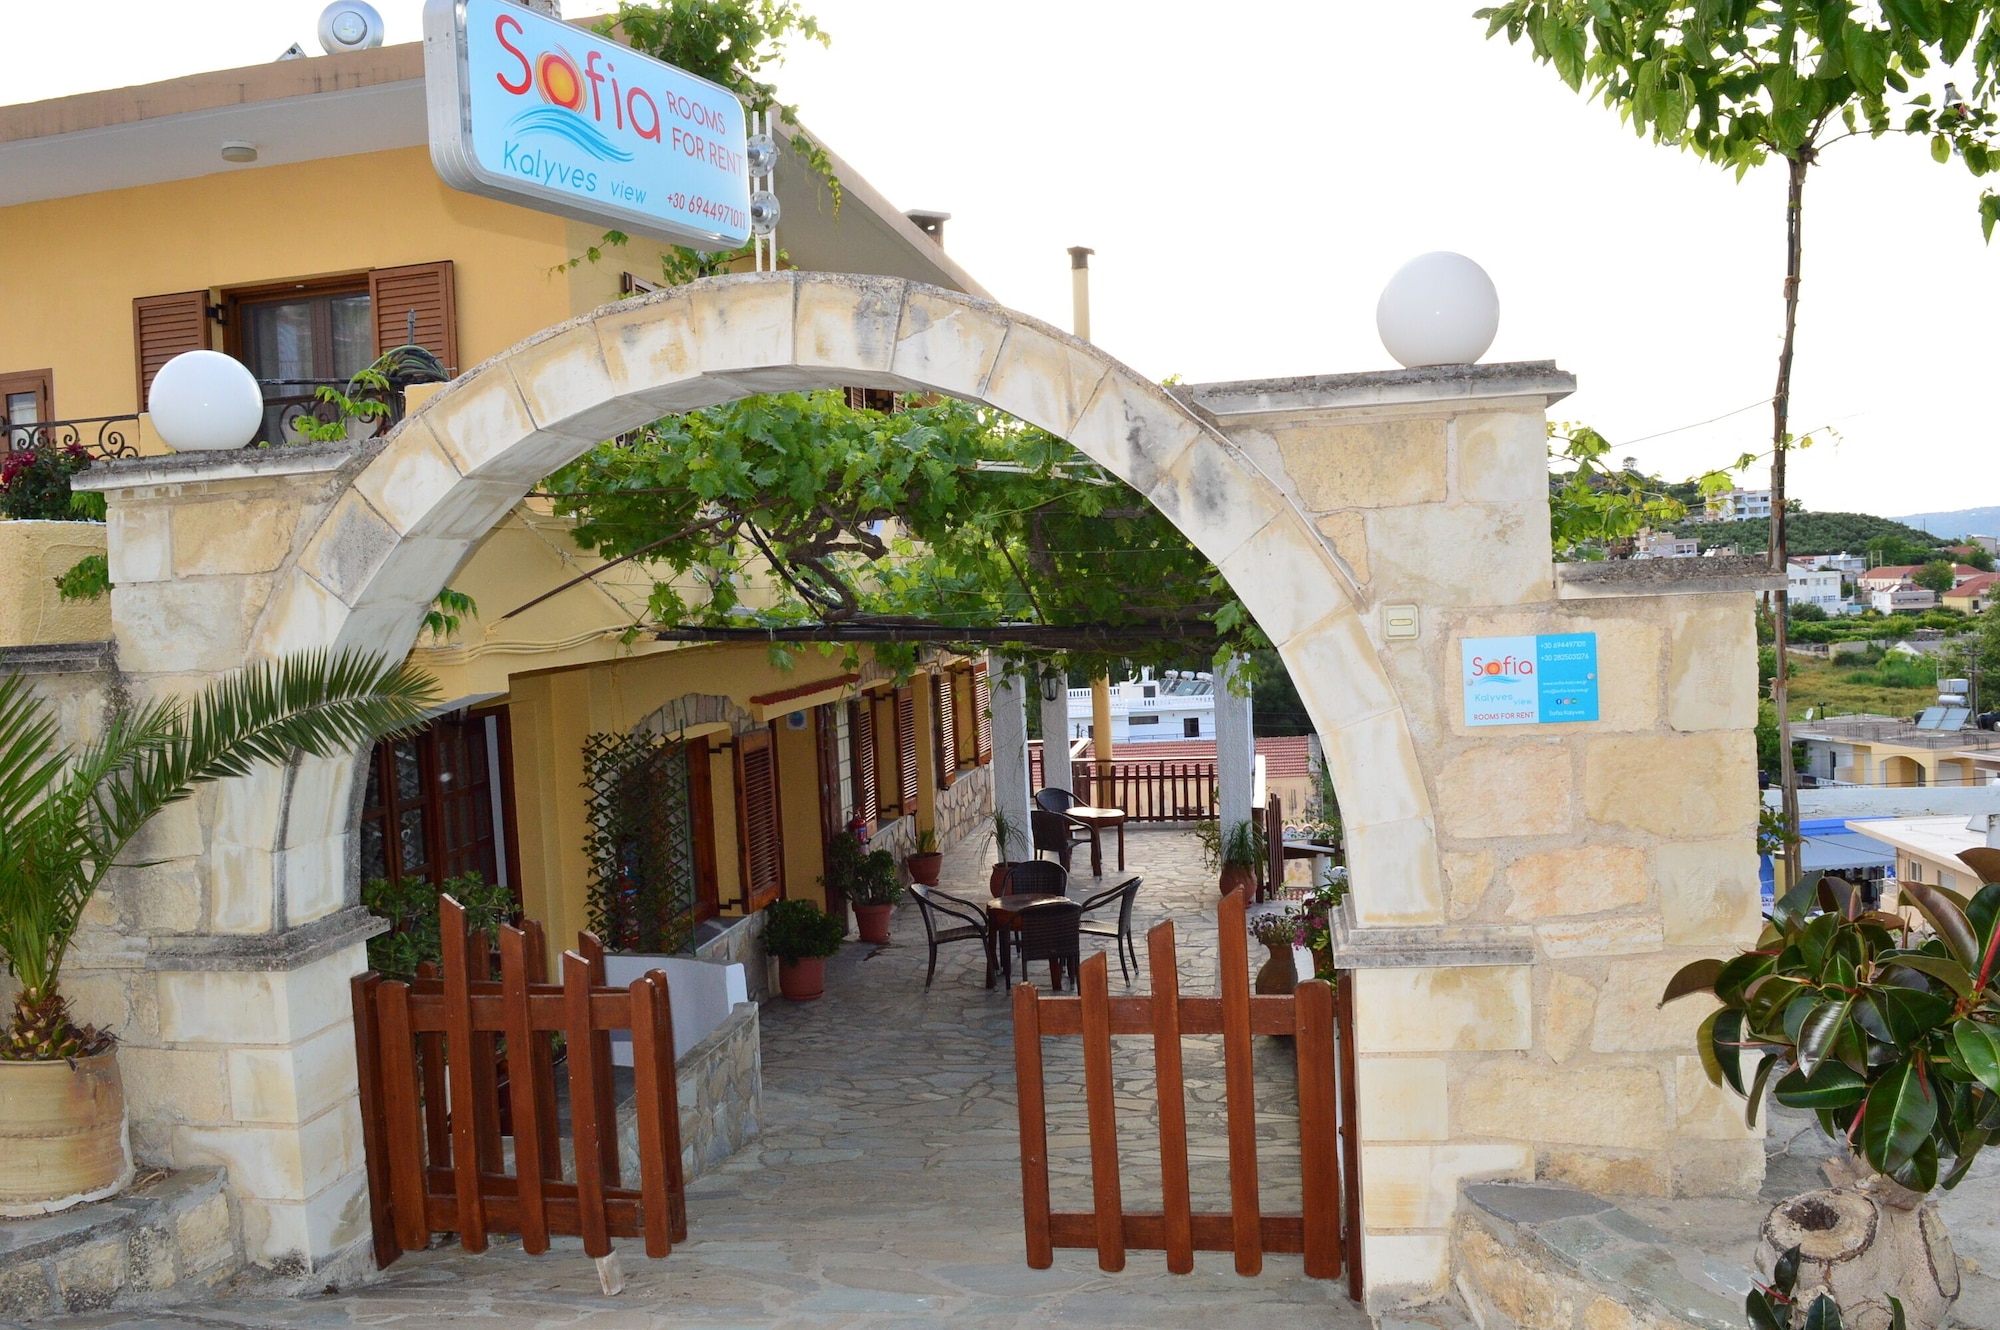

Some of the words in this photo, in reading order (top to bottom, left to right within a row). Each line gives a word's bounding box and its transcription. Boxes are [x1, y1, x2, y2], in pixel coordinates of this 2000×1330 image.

[494, 14, 662, 144] Sofia
[666, 90, 726, 135] ROOMS
[672, 127, 706, 163] FOR
[709, 140, 743, 178] RENT
[503, 140, 598, 192] Kalyves
[610, 179, 648, 205] view
[667, 192, 686, 210] +30
[688, 195, 746, 230] 6944971011
[1472, 655, 1534, 677] Sofia
[1541, 654, 1552, 662] +30
[1474, 692, 1514, 704] Kalyves
[1513, 698, 1533, 706] view
[1474, 713, 1499, 721] ROOMS
[1500, 712, 1515, 720] FOR
[1516, 711, 1535, 719] RENT
